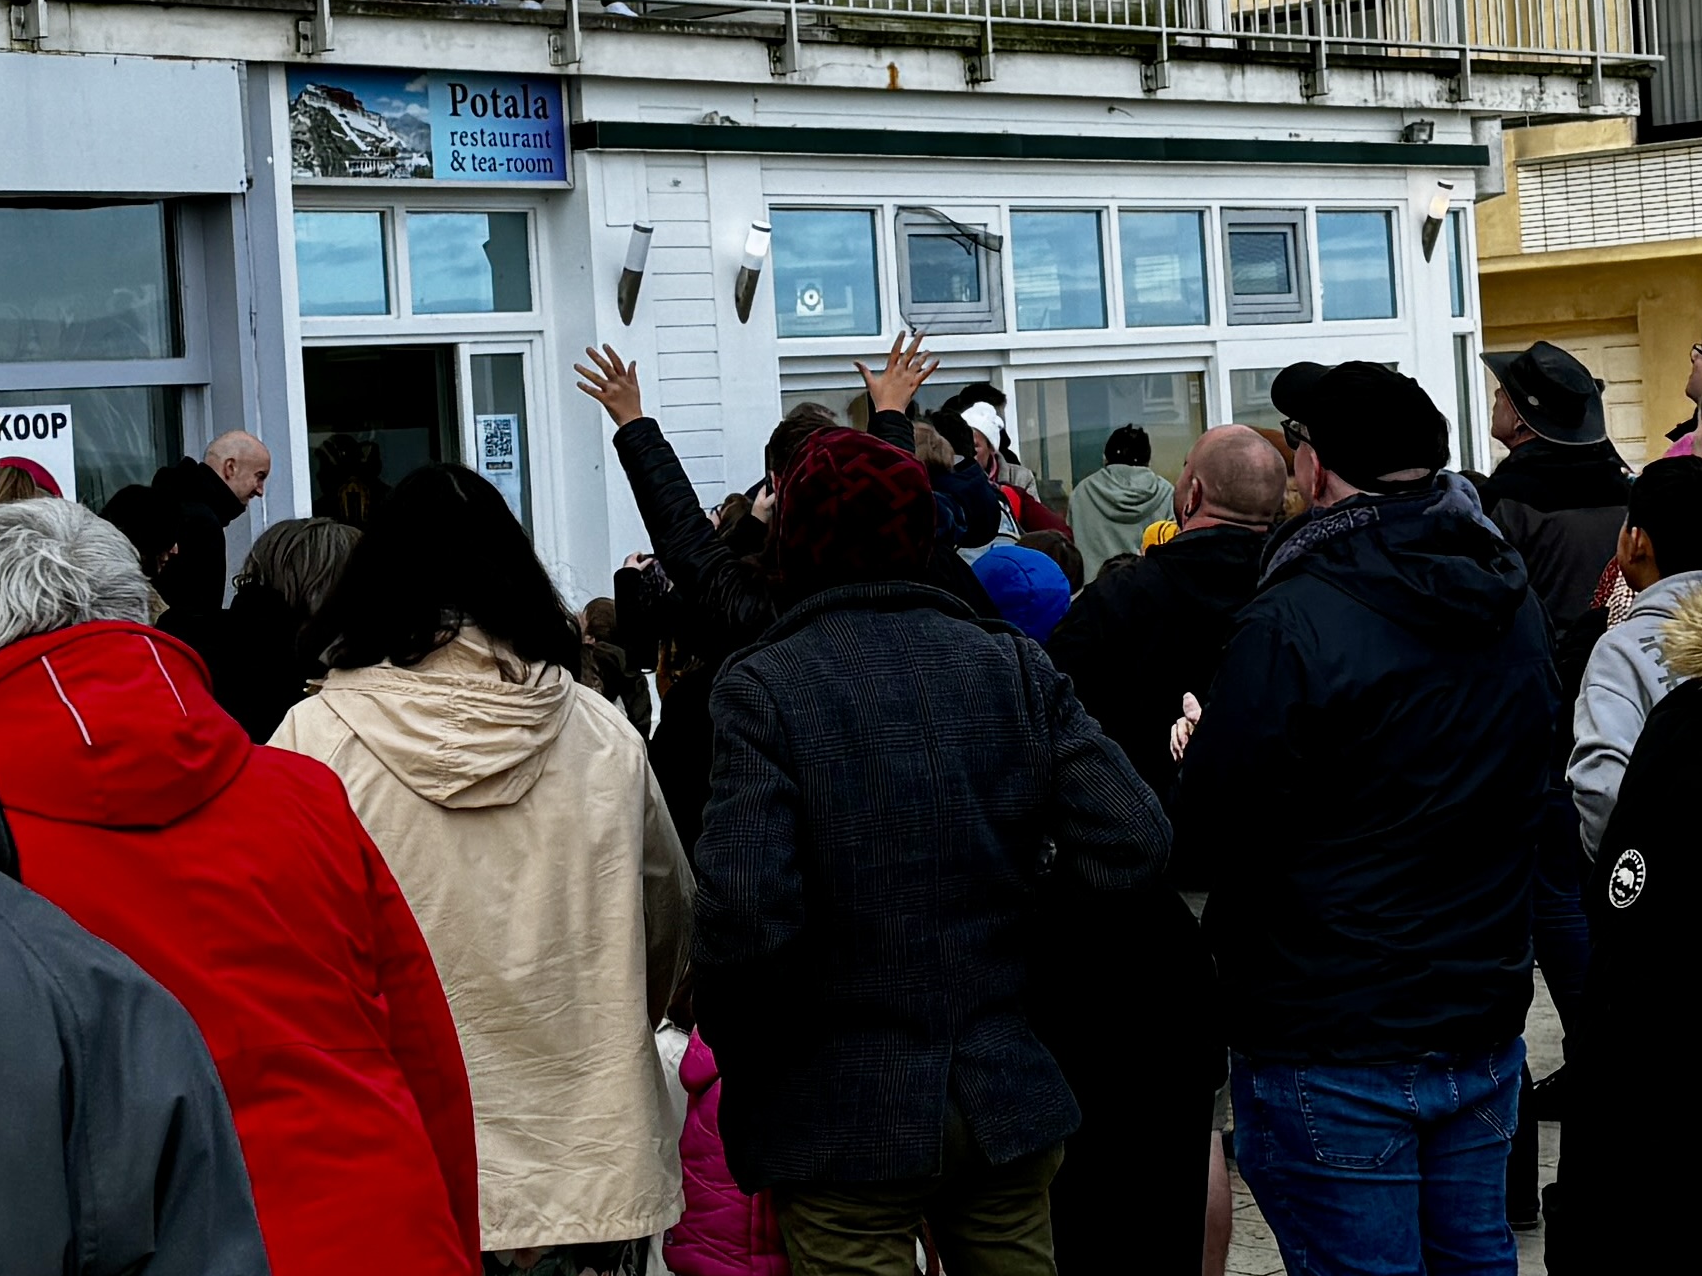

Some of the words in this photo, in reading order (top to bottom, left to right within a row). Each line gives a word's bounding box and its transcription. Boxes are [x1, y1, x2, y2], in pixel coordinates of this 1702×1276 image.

[447, 82, 550, 120] Potala
[450, 127, 552, 149] restaurant
[450, 150, 466, 173] &
[471, 152, 554, 174] tea-room
